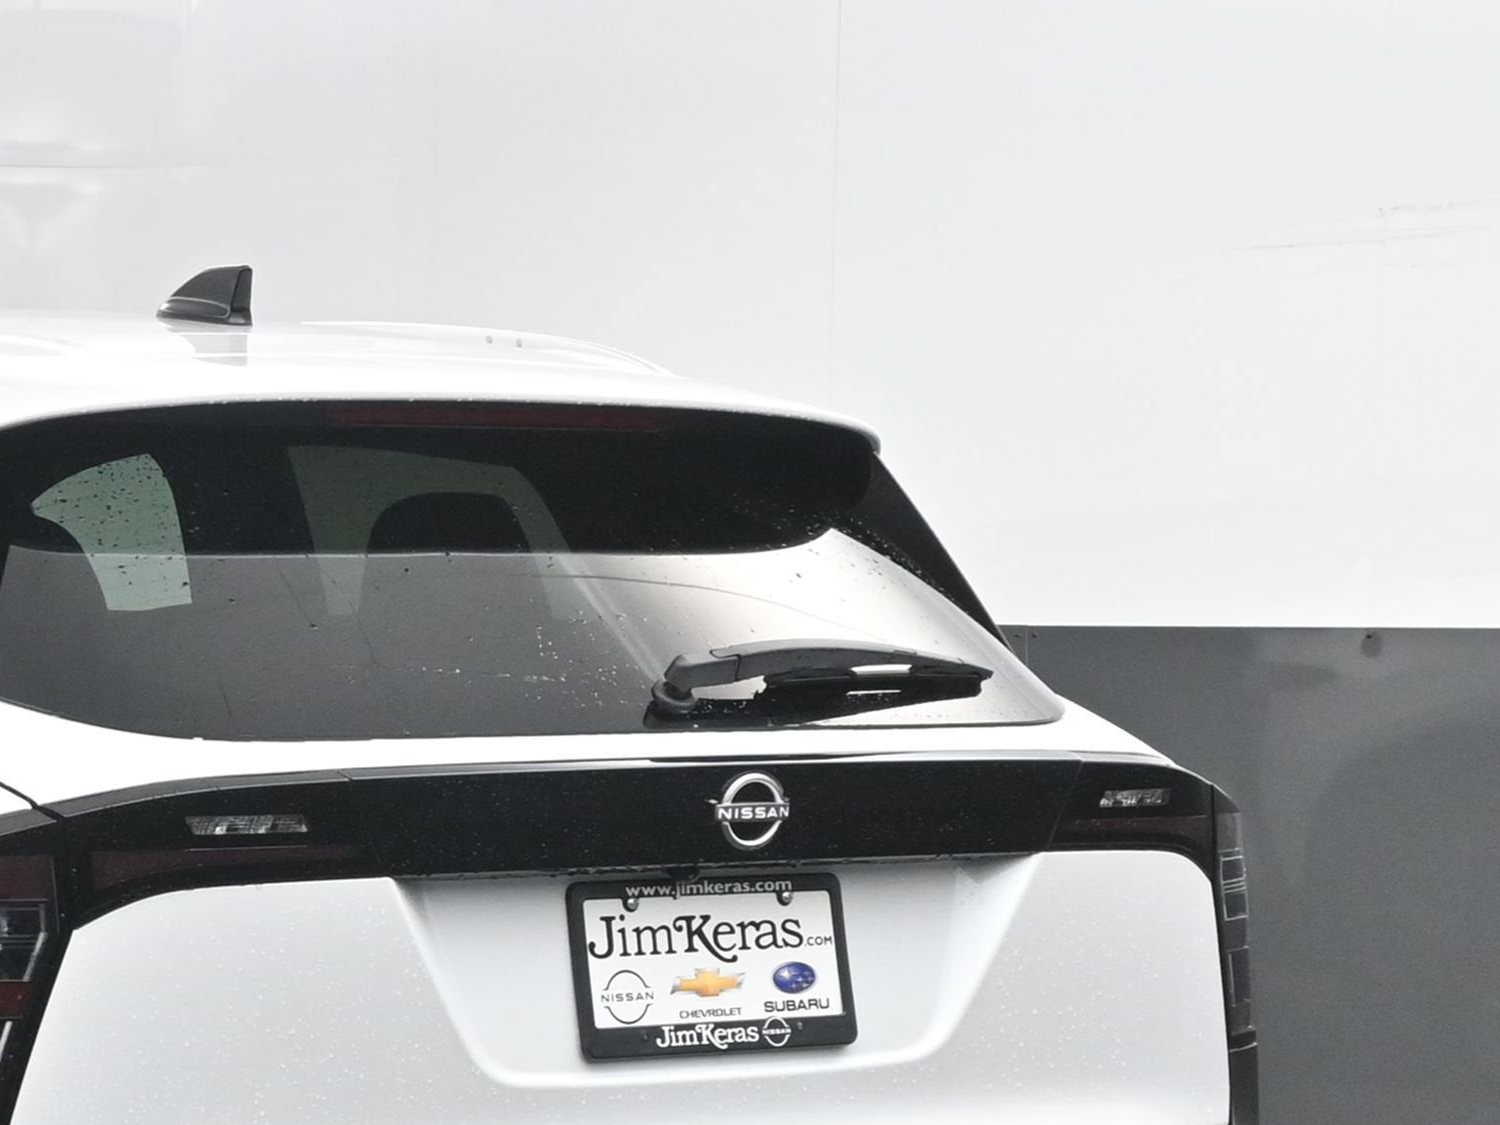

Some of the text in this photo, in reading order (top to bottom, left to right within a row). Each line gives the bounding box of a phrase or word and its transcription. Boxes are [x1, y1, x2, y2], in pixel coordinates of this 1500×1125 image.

[717, 804, 790, 821] NISSAN
[625, 880, 793, 899] www.jimkeras.com
[600, 991, 654, 1003] NISSAN
[679, 1007, 742, 1019] CHEVROLET
[764, 998, 830, 1013] SUBARU
